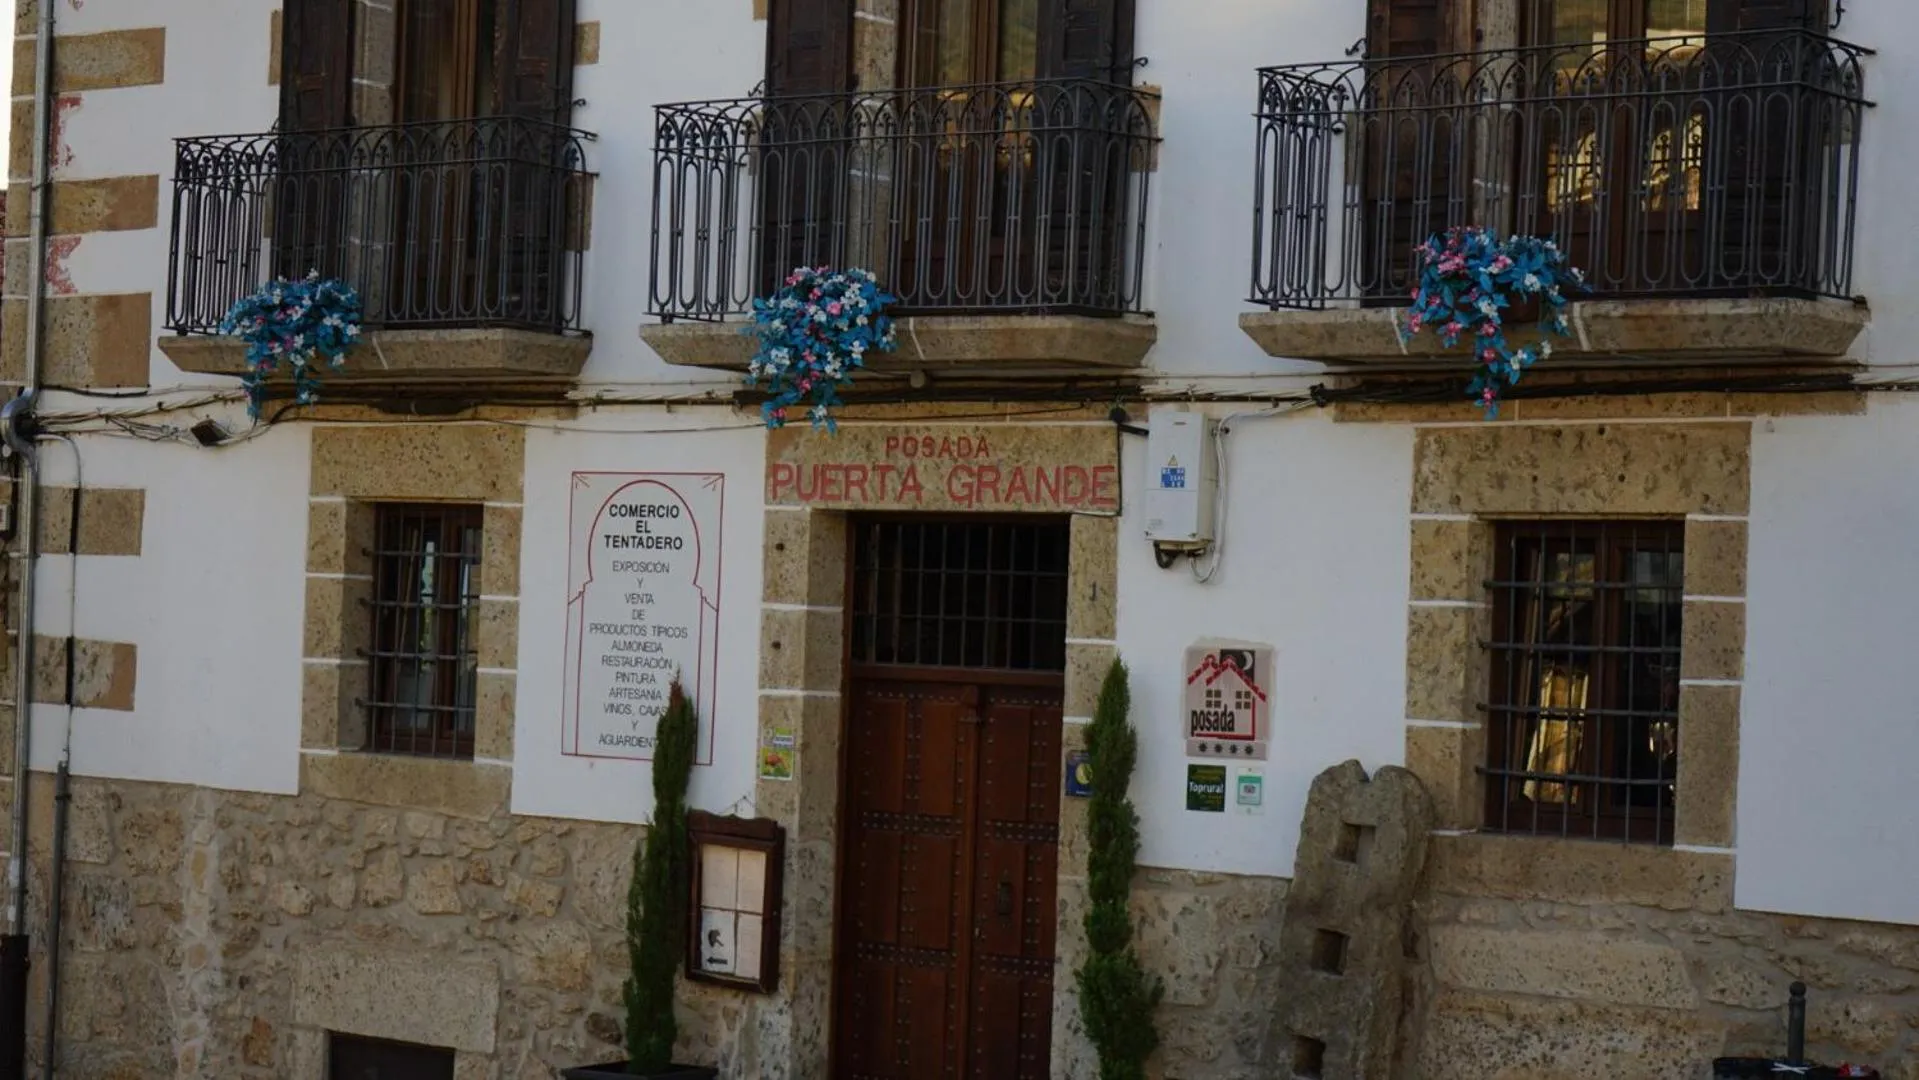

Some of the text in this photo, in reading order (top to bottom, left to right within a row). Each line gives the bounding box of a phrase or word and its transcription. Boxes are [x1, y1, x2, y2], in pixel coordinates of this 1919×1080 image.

[886, 436, 990, 458] POSADA
[770, 463, 922, 502] PUERTA
[946, 463, 1115, 509] GRANDE
[609, 504, 680, 518] COMERCIO
[635, 520, 651, 533] EL
[604, 535, 683, 550] TENTADERO
[636, 577, 644, 589] Y
[624, 593, 654, 604] VENTA
[632, 609, 645, 620] DE
[589, 622, 647, 637] PRODUCTOS
[611, 640, 663, 653] ALMONEDA
[601, 654, 673, 669] RESTAURACIÓN
[615, 672, 656, 684] PINTURA
[631, 720, 639, 731] Y
[1191, 704, 1235, 738] posada
[598, 733, 658, 749] AGUARDIENT
[1189, 781, 1224, 795] Toprural
